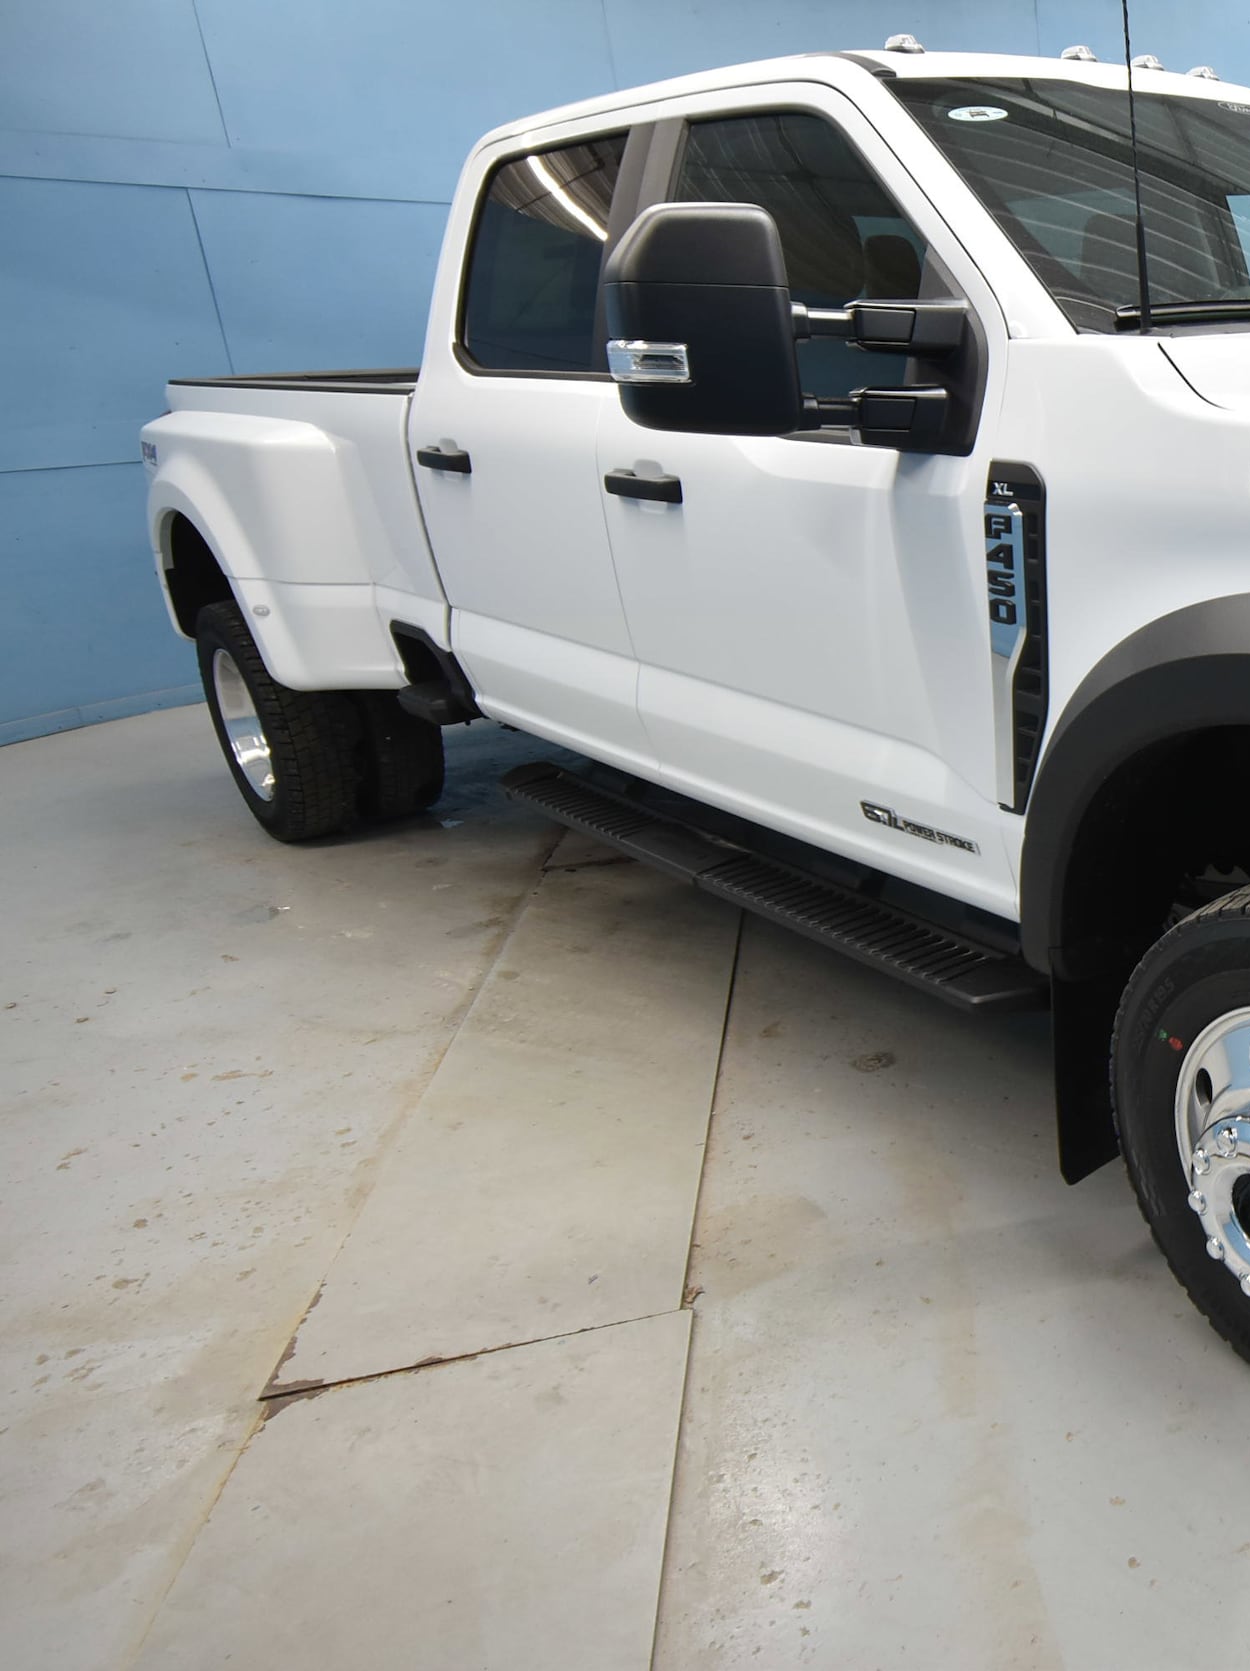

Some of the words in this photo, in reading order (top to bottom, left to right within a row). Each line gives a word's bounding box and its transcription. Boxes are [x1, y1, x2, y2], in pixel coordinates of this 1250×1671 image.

[992, 482, 1014, 497] XL
[984, 513, 1017, 626] F450
[902, 819, 936, 840] POWER
[936, 831, 975, 852] STROKE
